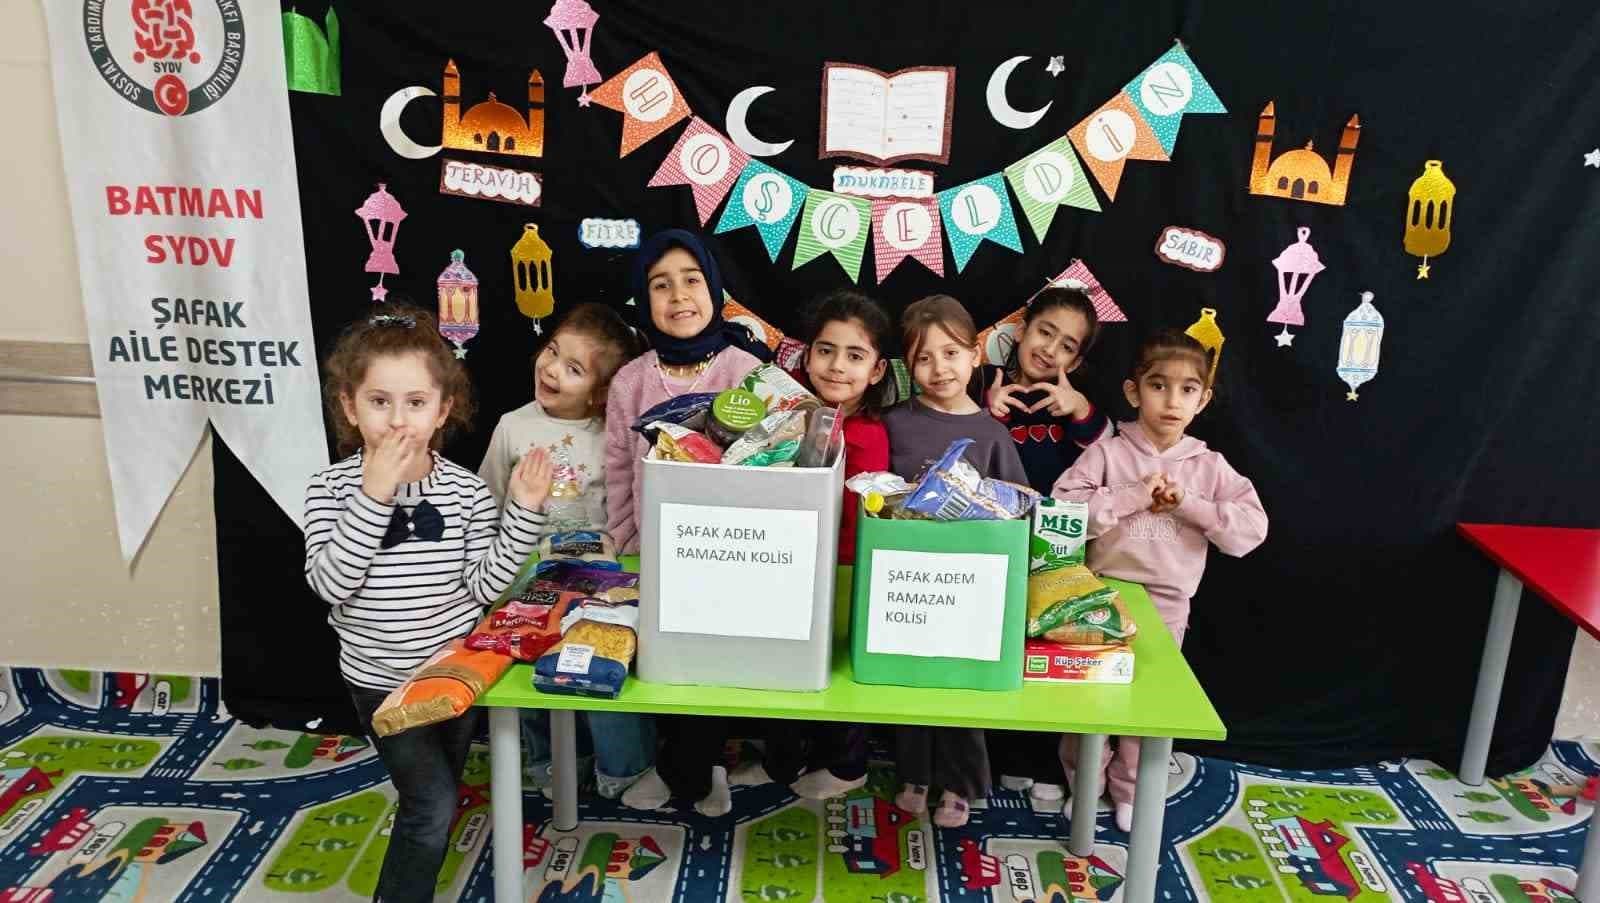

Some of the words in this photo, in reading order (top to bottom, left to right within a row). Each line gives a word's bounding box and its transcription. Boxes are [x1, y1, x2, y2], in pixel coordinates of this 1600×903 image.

[153, 62, 183, 73] SYDV
[100, 57, 141, 101] SOSYAL
[105, 185, 265, 219] BATMAN
[144, 235, 236, 268] SYDV
[151, 297, 247, 330] ŞAFAK
[108, 330, 179, 363] AİLE
[185, 337, 302, 367] DESTEK
[143, 373, 275, 405] MERKEZİ
[730, 393, 751, 406] Lio
[676, 524, 720, 539] ŞAFAK
[723, 527, 767, 542] ADEM
[676, 546, 747, 563] RAMAZAN
[751, 549, 793, 565] KOLİSİ
[887, 569, 930, 584] ŞAFAK
[934, 572, 976, 585] ADEM
[886, 591, 956, 606] RAMAZAN
[885, 610, 928, 625] KOLİSİ
[157, 691, 168, 710] car
